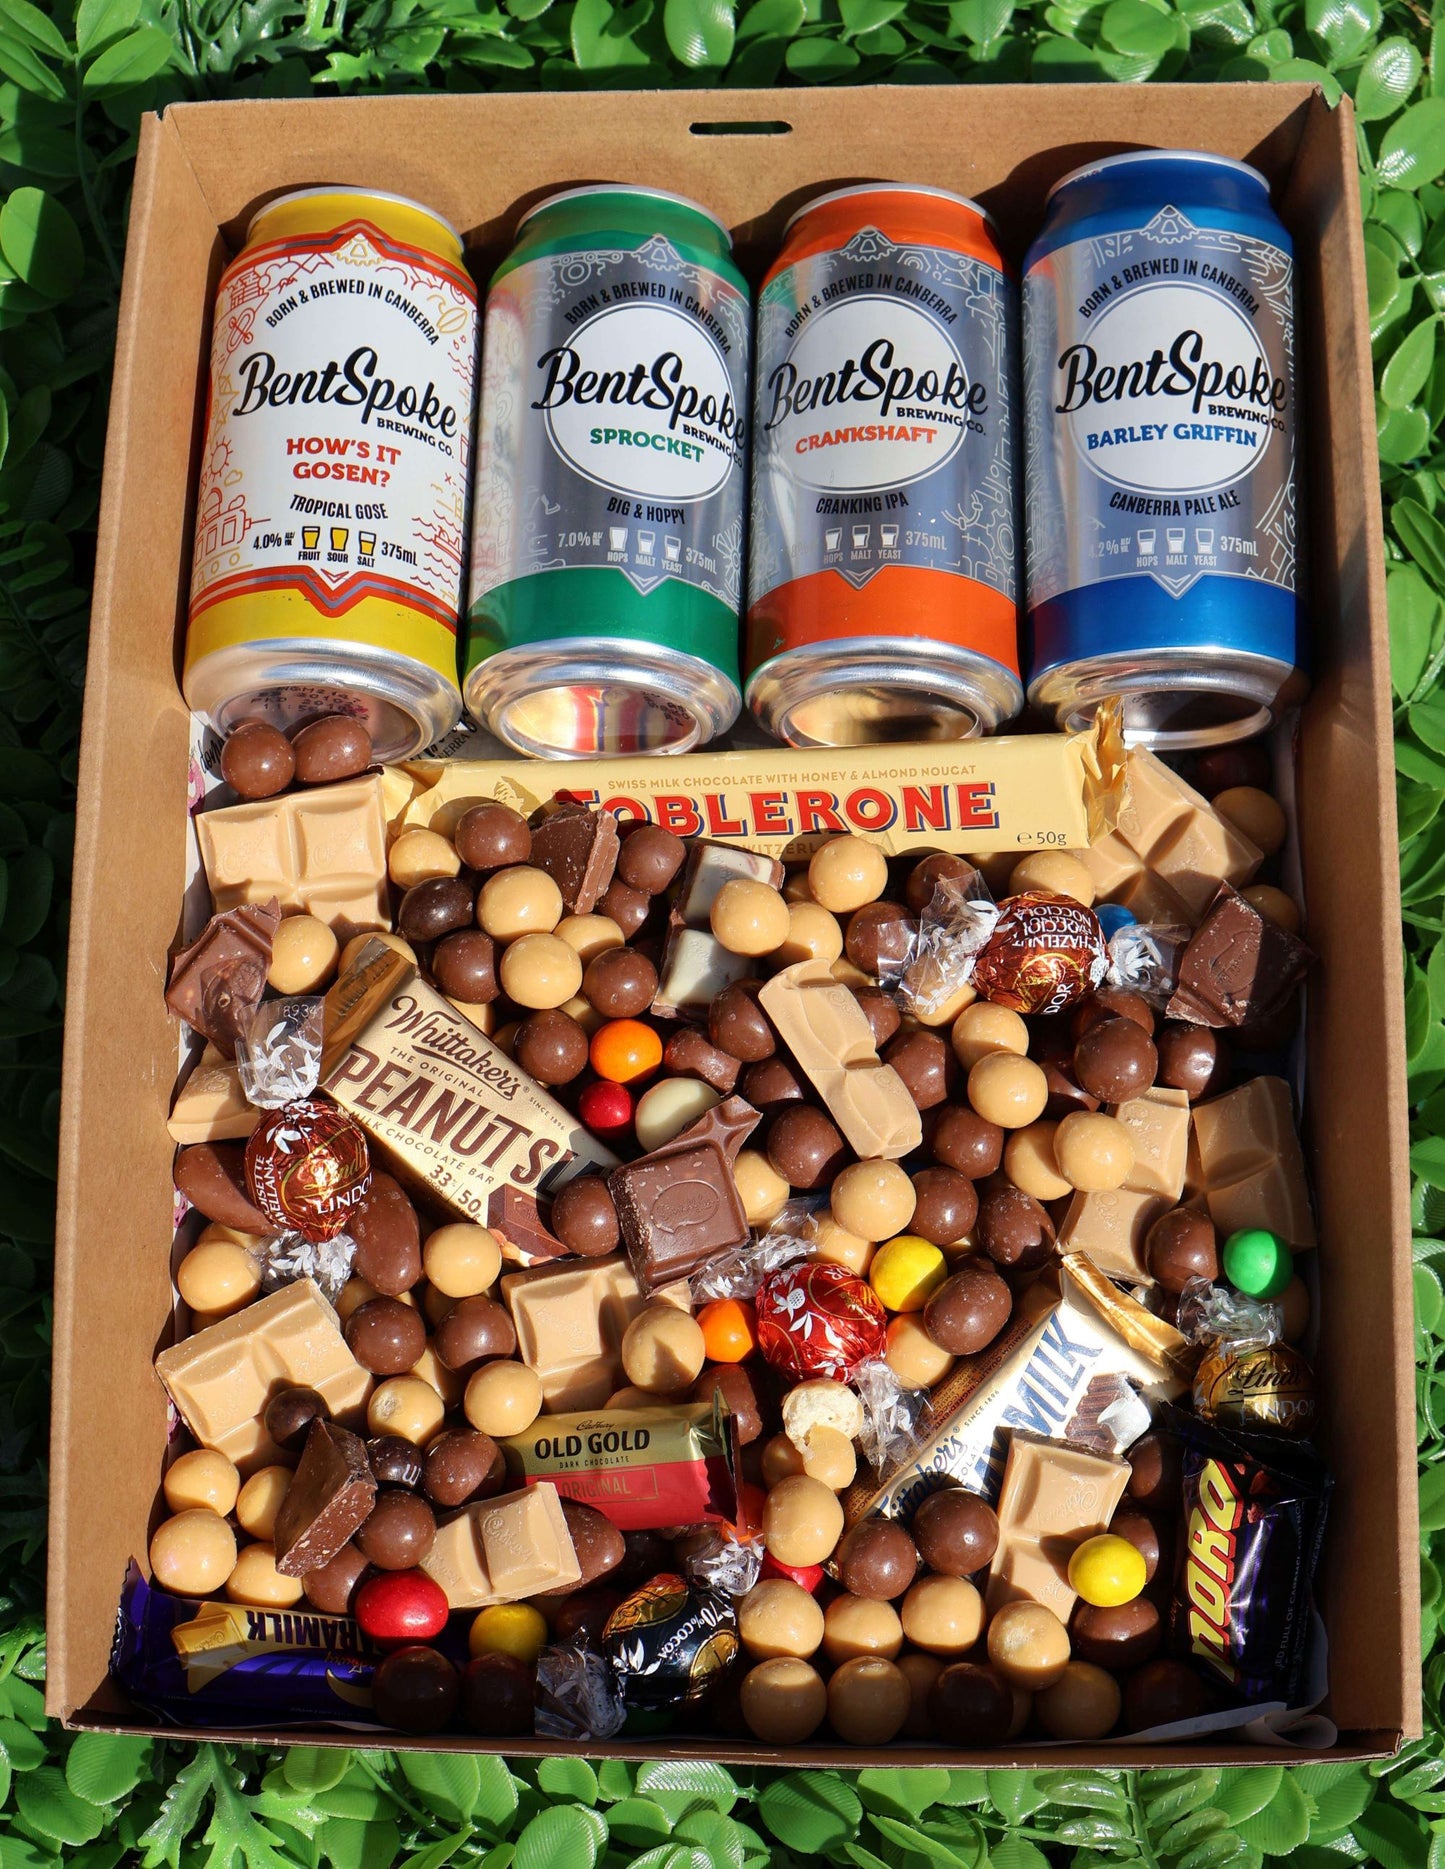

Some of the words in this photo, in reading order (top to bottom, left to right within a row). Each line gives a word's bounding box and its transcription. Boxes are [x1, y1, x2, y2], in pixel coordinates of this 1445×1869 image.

[1078, 283, 1112, 319] BORN
[1111, 275, 1123, 290] &
[1123, 258, 1179, 284] BREWED
[1183, 259, 1198, 276] IN
[1201, 263, 1260, 316] CANBERRA
[265, 293, 299, 328] BORN
[299, 289, 310, 305] &
[310, 279, 365, 299] BREWED
[368, 282, 383, 299] IN
[384, 289, 440, 347] CANBERRA
[564, 295, 603, 325] BORN
[600, 289, 611, 303] &
[612, 281, 666, 300] BREWED
[669, 287, 683, 302] IN
[684, 295, 732, 356] CANBERRA
[785, 304, 812, 339] BORN
[811, 295, 822, 309] &
[821, 273, 874, 300] BREWED
[877, 273, 893, 289] IN
[895, 277, 958, 326] CANBERRA
[764, 339, 988, 431] BentSpoke
[1055, 329, 1288, 414] BentSpoke
[232, 346, 458, 438] BentSpoke
[530, 346, 746, 450] BentSpoke
[896, 407, 963, 428] BREWING
[966, 419, 987, 436] CO.
[1208, 404, 1269, 425] BREWING
[1270, 417, 1288, 433] CO.
[377, 418, 436, 447] BREWING
[438, 441, 455, 460] CO.
[590, 427, 705, 463] SPROCKET
[682, 423, 733, 458] BREWING
[795, 425, 937, 454] CRANKSHAFT
[1087, 423, 1168, 450] BARLEY
[1173, 422, 1257, 448] GRIFFIN
[286, 438, 371, 459] HOW'S
[377, 444, 402, 466] IT
[292, 462, 391, 488] GOSEN?
[290, 494, 352, 519] TROPICAL
[355, 503, 389, 520] GOSE
[606, 496, 631, 517] BIG
[633, 504, 643, 518] &
[646, 506, 686, 525] HOPPY
[815, 495, 883, 515] CRANKING
[885, 491, 909, 510] IPA
[1109, 491, 1181, 517] CANBERRA
[1185, 496, 1218, 517] PALE
[1219, 489, 1242, 508] ALE
[253, 532, 282, 550] 4.0%
[558, 530, 591, 548] 7.0%
[905, 531, 947, 550] 375mL
[1220, 535, 1259, 557] 375mL
[298, 551, 321, 561] FRUIT
[327, 552, 349, 563] SOUR
[357, 555, 375, 568] SALT
[381, 541, 418, 567] 375mL
[607, 551, 628, 563] HOPS
[635, 554, 656, 567] MALT
[661, 558, 683, 574] YEAST
[685, 547, 717, 575] 375mL
[823, 552, 844, 564] HOPS
[850, 550, 871, 560] MALT
[877, 550, 902, 560] YEAST
[1136, 556, 1159, 568] HOPS
[1166, 554, 1188, 565] MALT
[1193, 555, 1217, 567] YEAST
[608, 779, 647, 790] SWISS
[650, 778, 680, 788] MILK
[683, 775, 763, 787] CHOCOLATE
[766, 773, 798, 783] WITH
[802, 771, 846, 782] HONEY
[850, 771, 858, 780] &
[862, 767, 918, 780] ALMOND
[921, 765, 976, 776] NOUGAT
[744, 842, 818, 855] WITZERL
[1036, 831, 1067, 846] 50g
[385, 995, 523, 1102] Whittaker's
[390, 1046, 416, 1064] THE
[420, 1061, 483, 1098] ORIGINAL
[529, 1096, 551, 1118] SINCE
[349, 1110, 380, 1131] MILK
[386, 1128, 465, 1172] CHOCOLATE
[467, 1165, 495, 1185] BAR
[1002, 1311, 1103, 1436] MILK
[964, 1405, 985, 1427] SINCE
[534, 1435, 582, 1460] OLD
[588, 1429, 650, 1455] GOLD
[559, 1461, 580, 1469] DARK
[584, 1456, 630, 1467] CHOCOLATE
[880, 1433, 968, 1516] ittaker's
[562, 1475, 631, 1499] ORIGINAL
[690, 1600, 724, 1630] 70%
[247, 1609, 366, 1654] RAMILK
